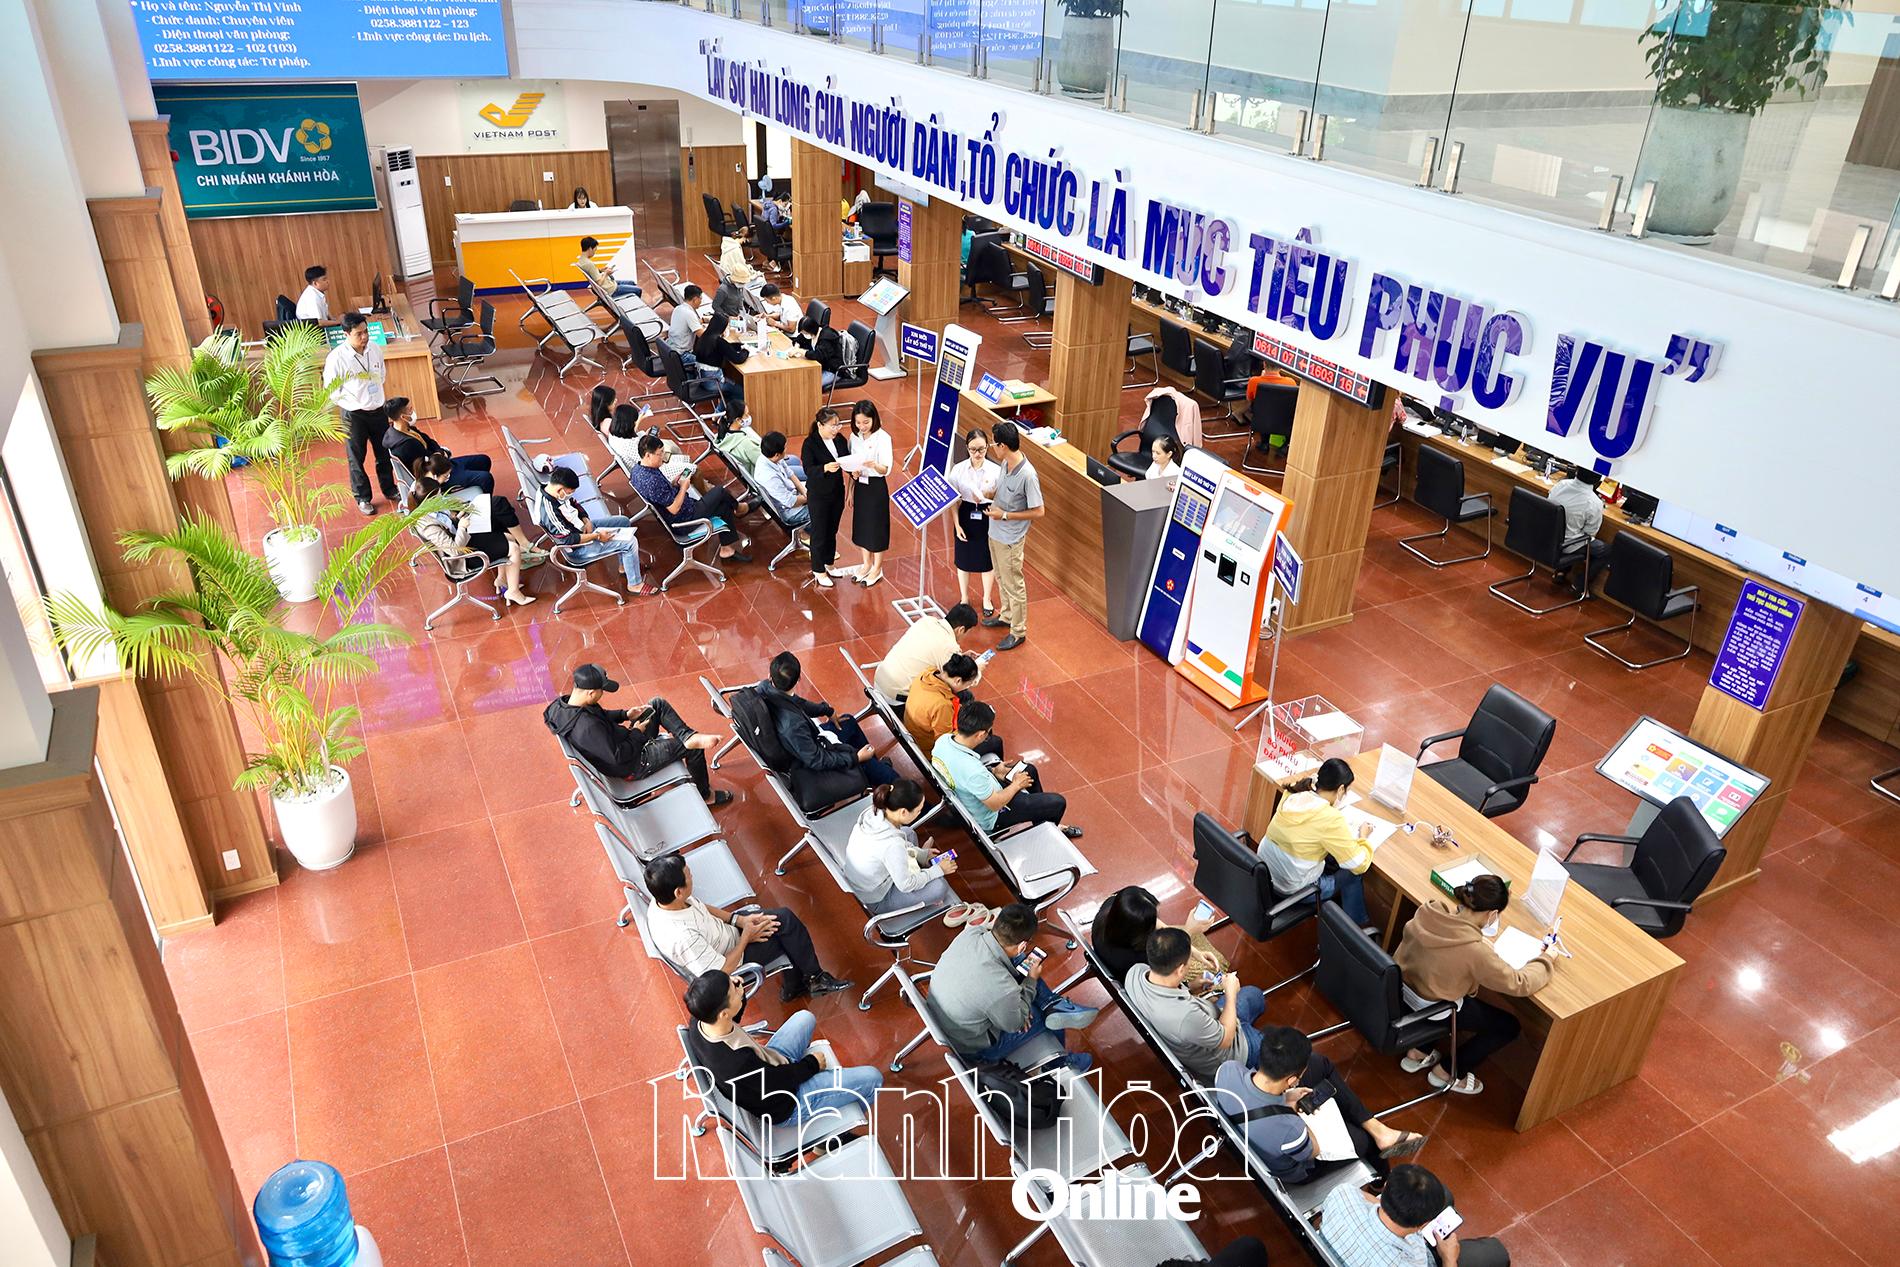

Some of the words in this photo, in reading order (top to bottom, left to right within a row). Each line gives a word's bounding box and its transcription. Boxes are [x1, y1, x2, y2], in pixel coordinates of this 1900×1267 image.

[451, 19, 469, 28] 123
[246, 43, 266, 53] 102
[268, 43, 297, 54] (103)
[528, 129, 557, 137] POST
[189, 127, 295, 166] BIDV
[196, 175, 219, 187] CHI
[221, 170, 266, 186] NHÁNH
[268, 168, 311, 184] KHÁNH
[314, 168, 340, 181] HÒA
[750, 60, 771, 118] HÀI
[775, 67, 810, 134] LÒNG
[815, 75, 846, 148] CỦA
[850, 96, 907, 172] NGƯỜI
[1004, 148, 1078, 237] CHỨC
[1087, 169, 1128, 261] LÀ
[1142, 200, 1232, 302] MỤC
[1248, 227, 1349, 341] TIÊU
[1358, 272, 1525, 413] PHỤC
[1254, 338, 1278, 358] 0614
[1281, 351, 1295, 365] 07
[1310, 361, 1335, 384] 1603
[1339, 377, 1353, 393] 16
